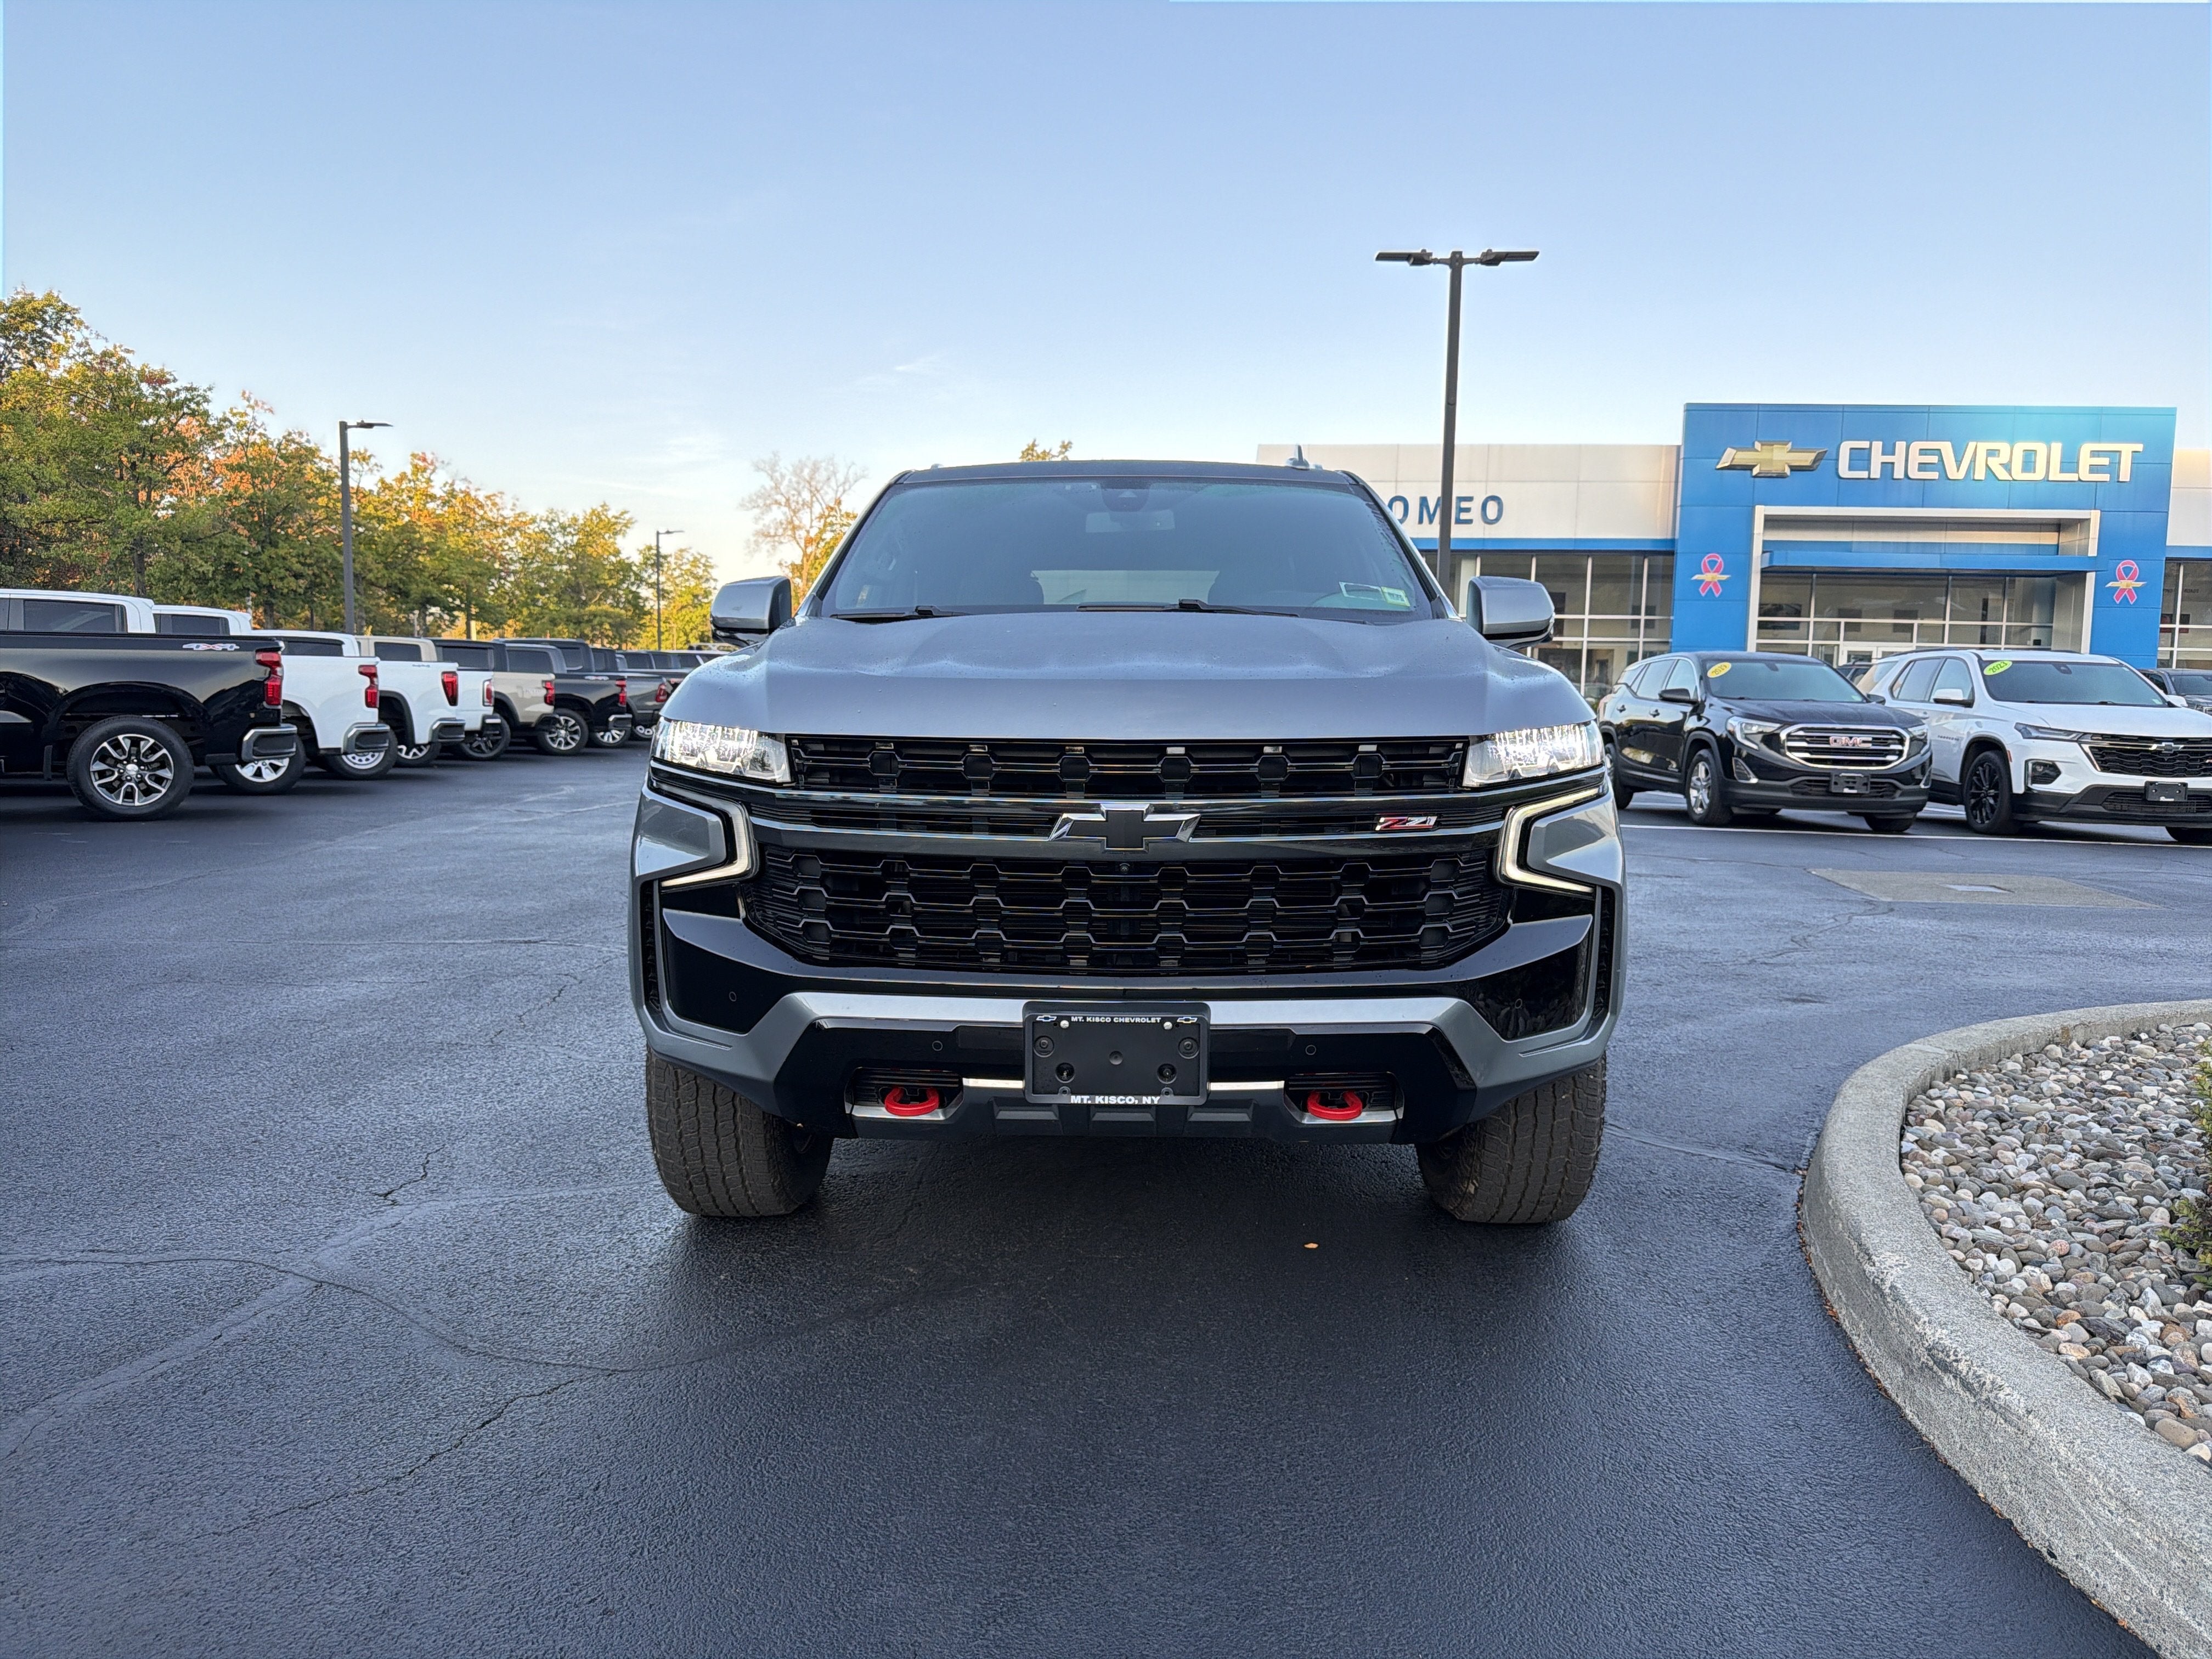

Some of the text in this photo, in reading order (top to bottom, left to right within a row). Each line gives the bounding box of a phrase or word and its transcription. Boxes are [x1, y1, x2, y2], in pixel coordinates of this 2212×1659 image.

[1838, 441, 2143, 482] CHEVROLET
[1988, 661, 2008, 673] 2023
[1829, 736, 1872, 747] GMC
[1375, 816, 1437, 831] Z71
[1070, 1095, 1161, 1104] MT. KISCO, NY
